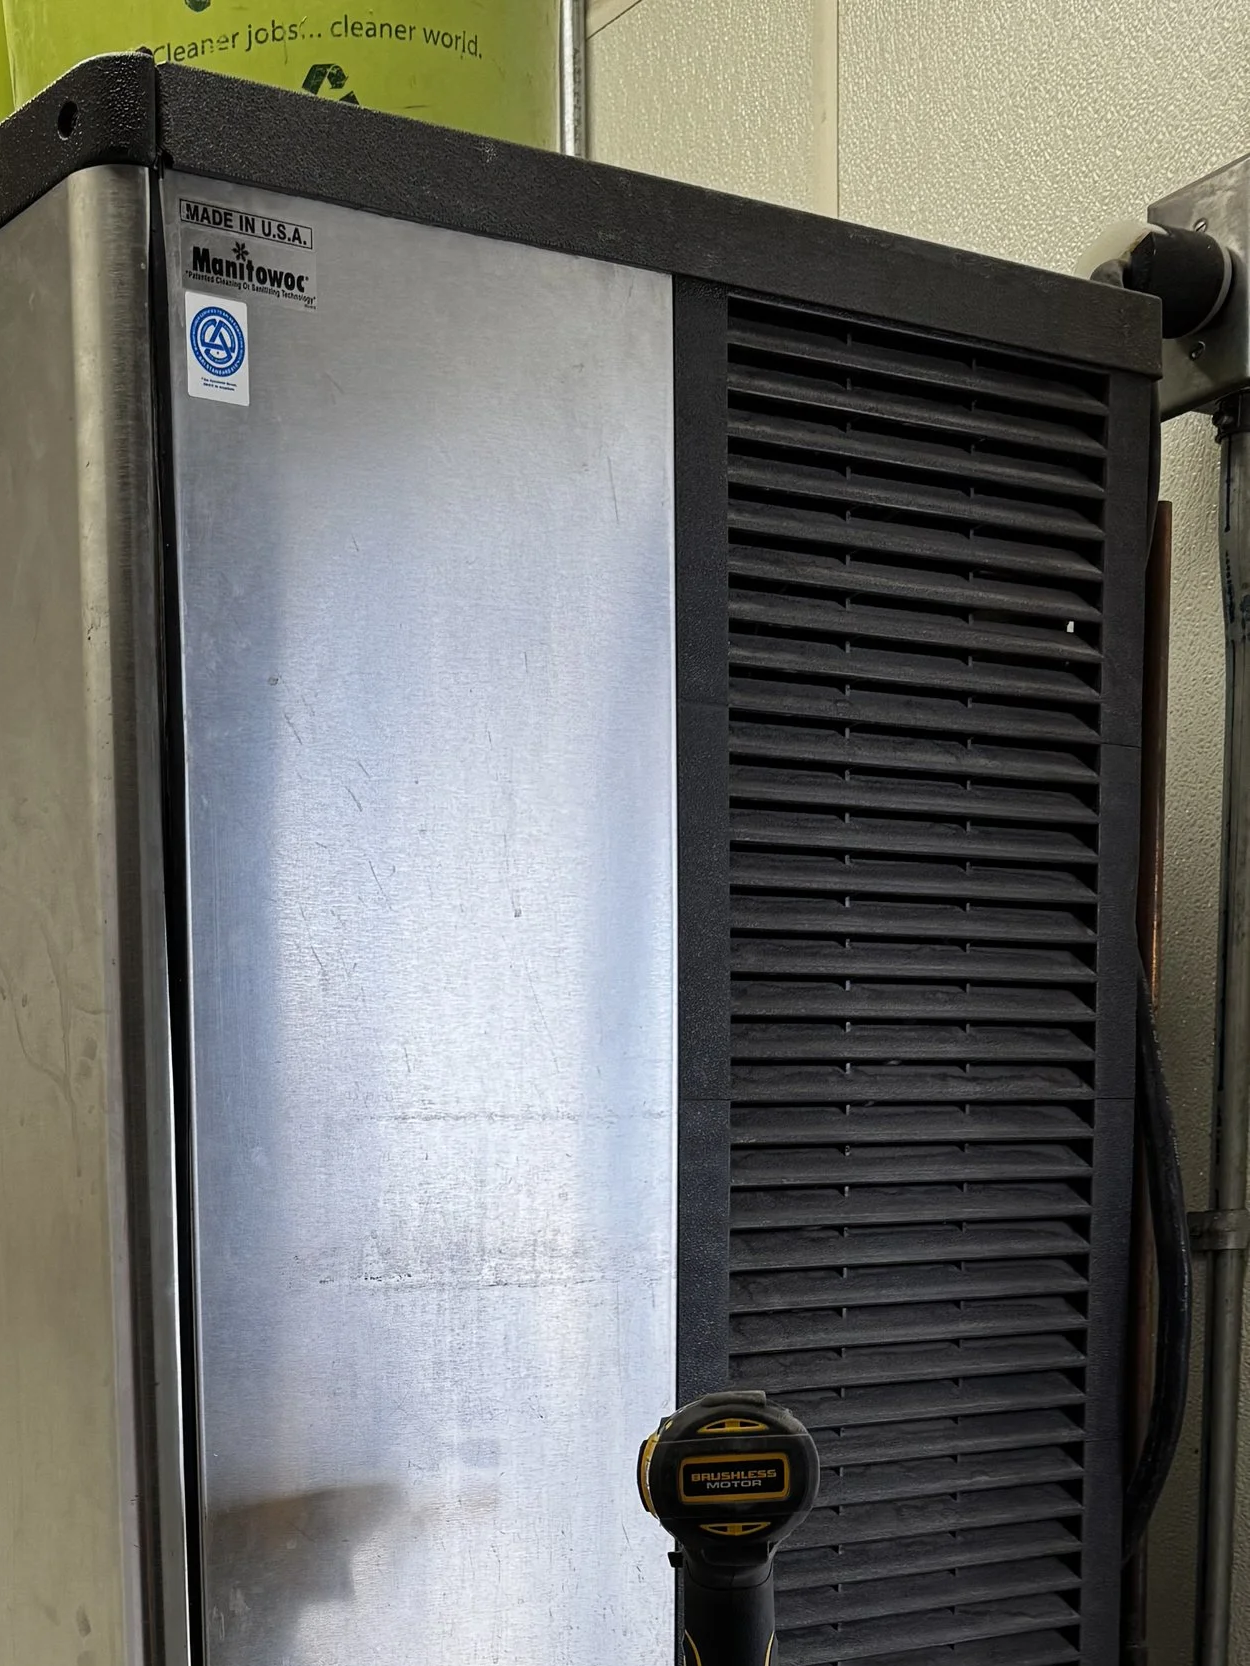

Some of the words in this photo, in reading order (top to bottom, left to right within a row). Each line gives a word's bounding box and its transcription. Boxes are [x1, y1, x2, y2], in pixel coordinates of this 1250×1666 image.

[330, 14, 417, 42] cleaner
[423, 25, 484, 59] world.
[185, 203, 233, 229] MADE
[239, 214, 256, 234] IN
[261, 219, 307, 246] U.S.A.
[192, 245, 306, 293] Manitowoc
[690, 1469, 777, 1483] BRUSHLESS
[706, 1479, 763, 1490] MOTOR
